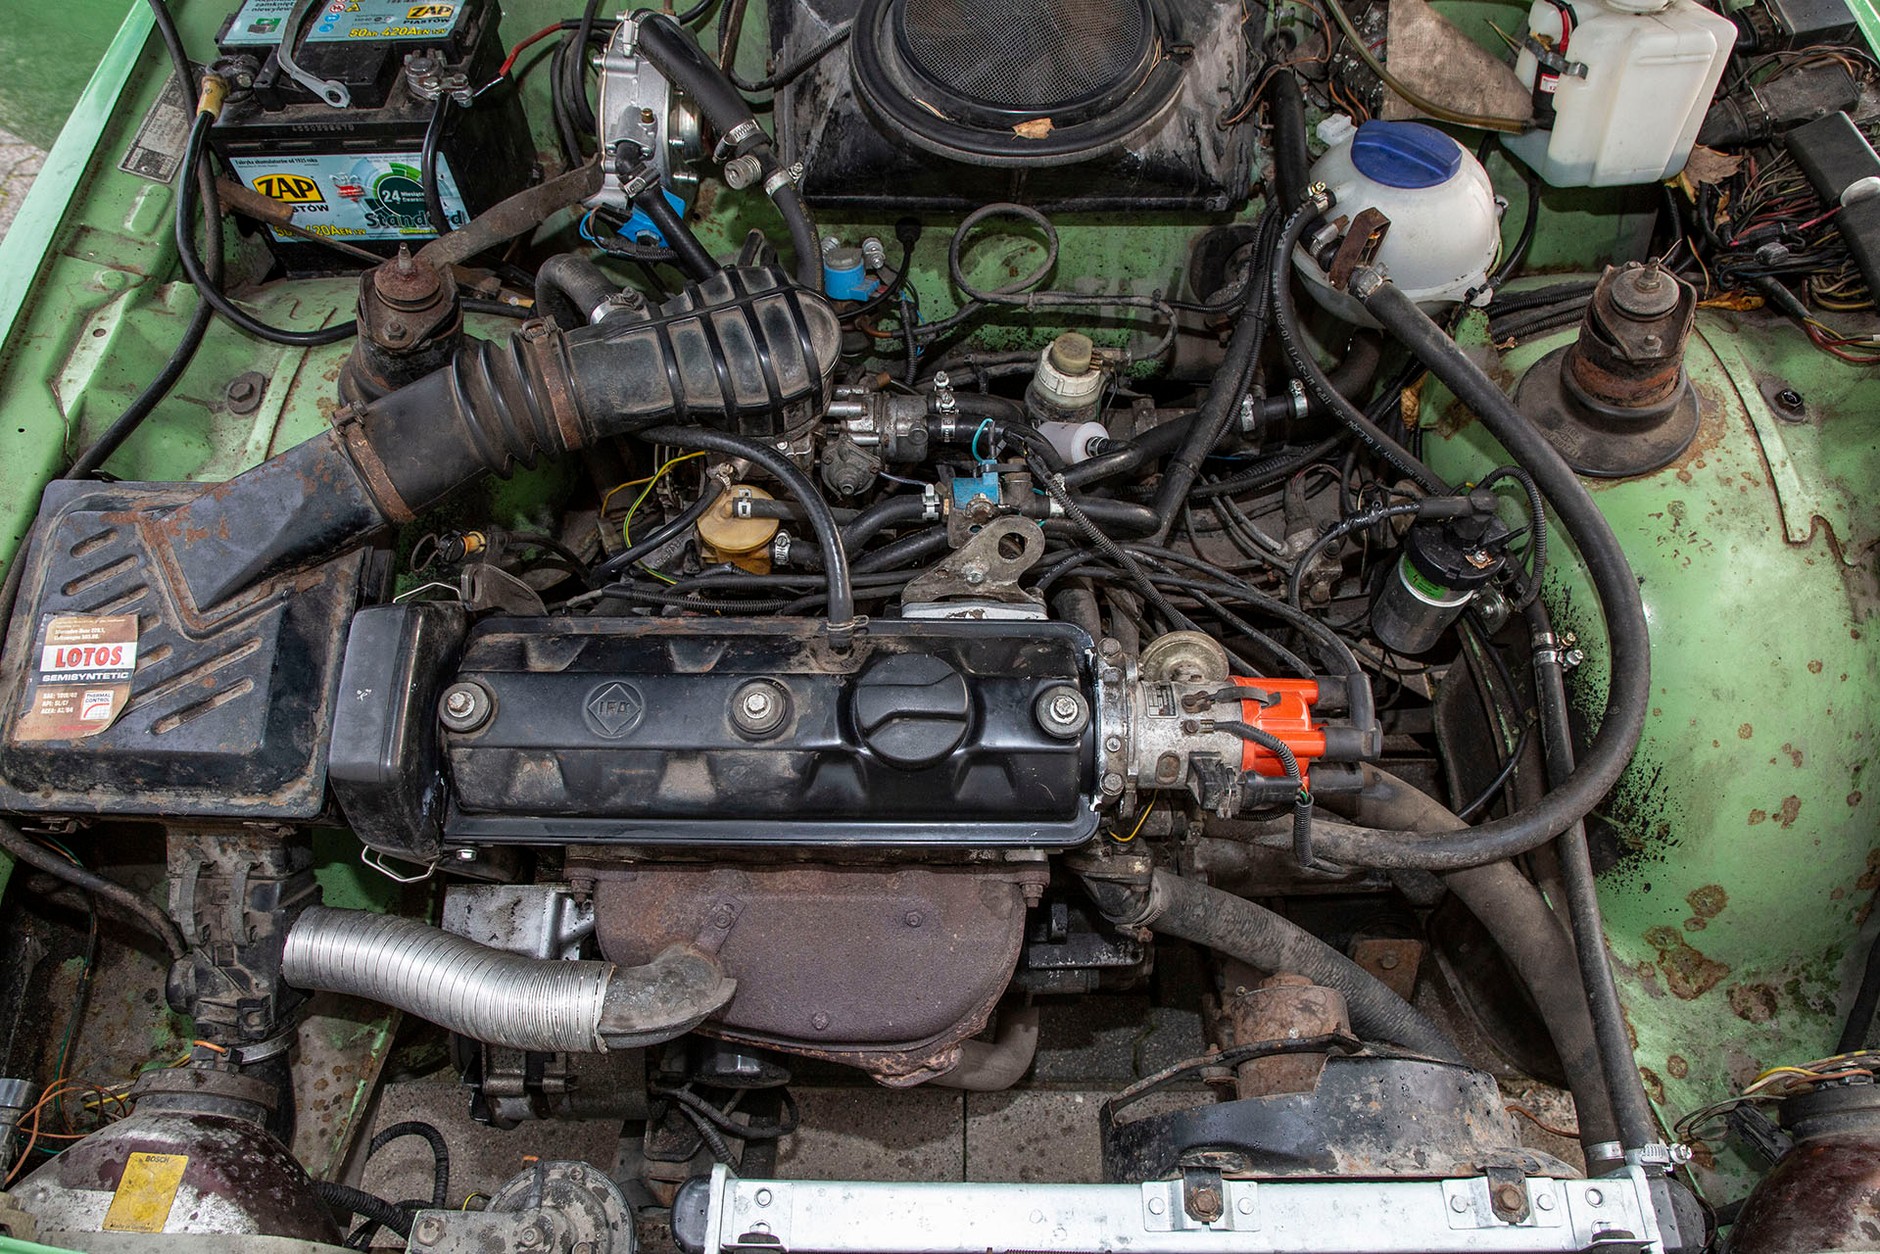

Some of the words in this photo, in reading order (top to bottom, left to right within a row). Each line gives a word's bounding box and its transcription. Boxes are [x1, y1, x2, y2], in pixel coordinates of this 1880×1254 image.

[409, 6, 452, 17] ZAP
[258, 177, 315, 199] ZAP
[381, 189, 401, 204] 24
[55, 646, 123, 668] LOTOS
[42, 671, 129, 682] SEMISYNTETIC
